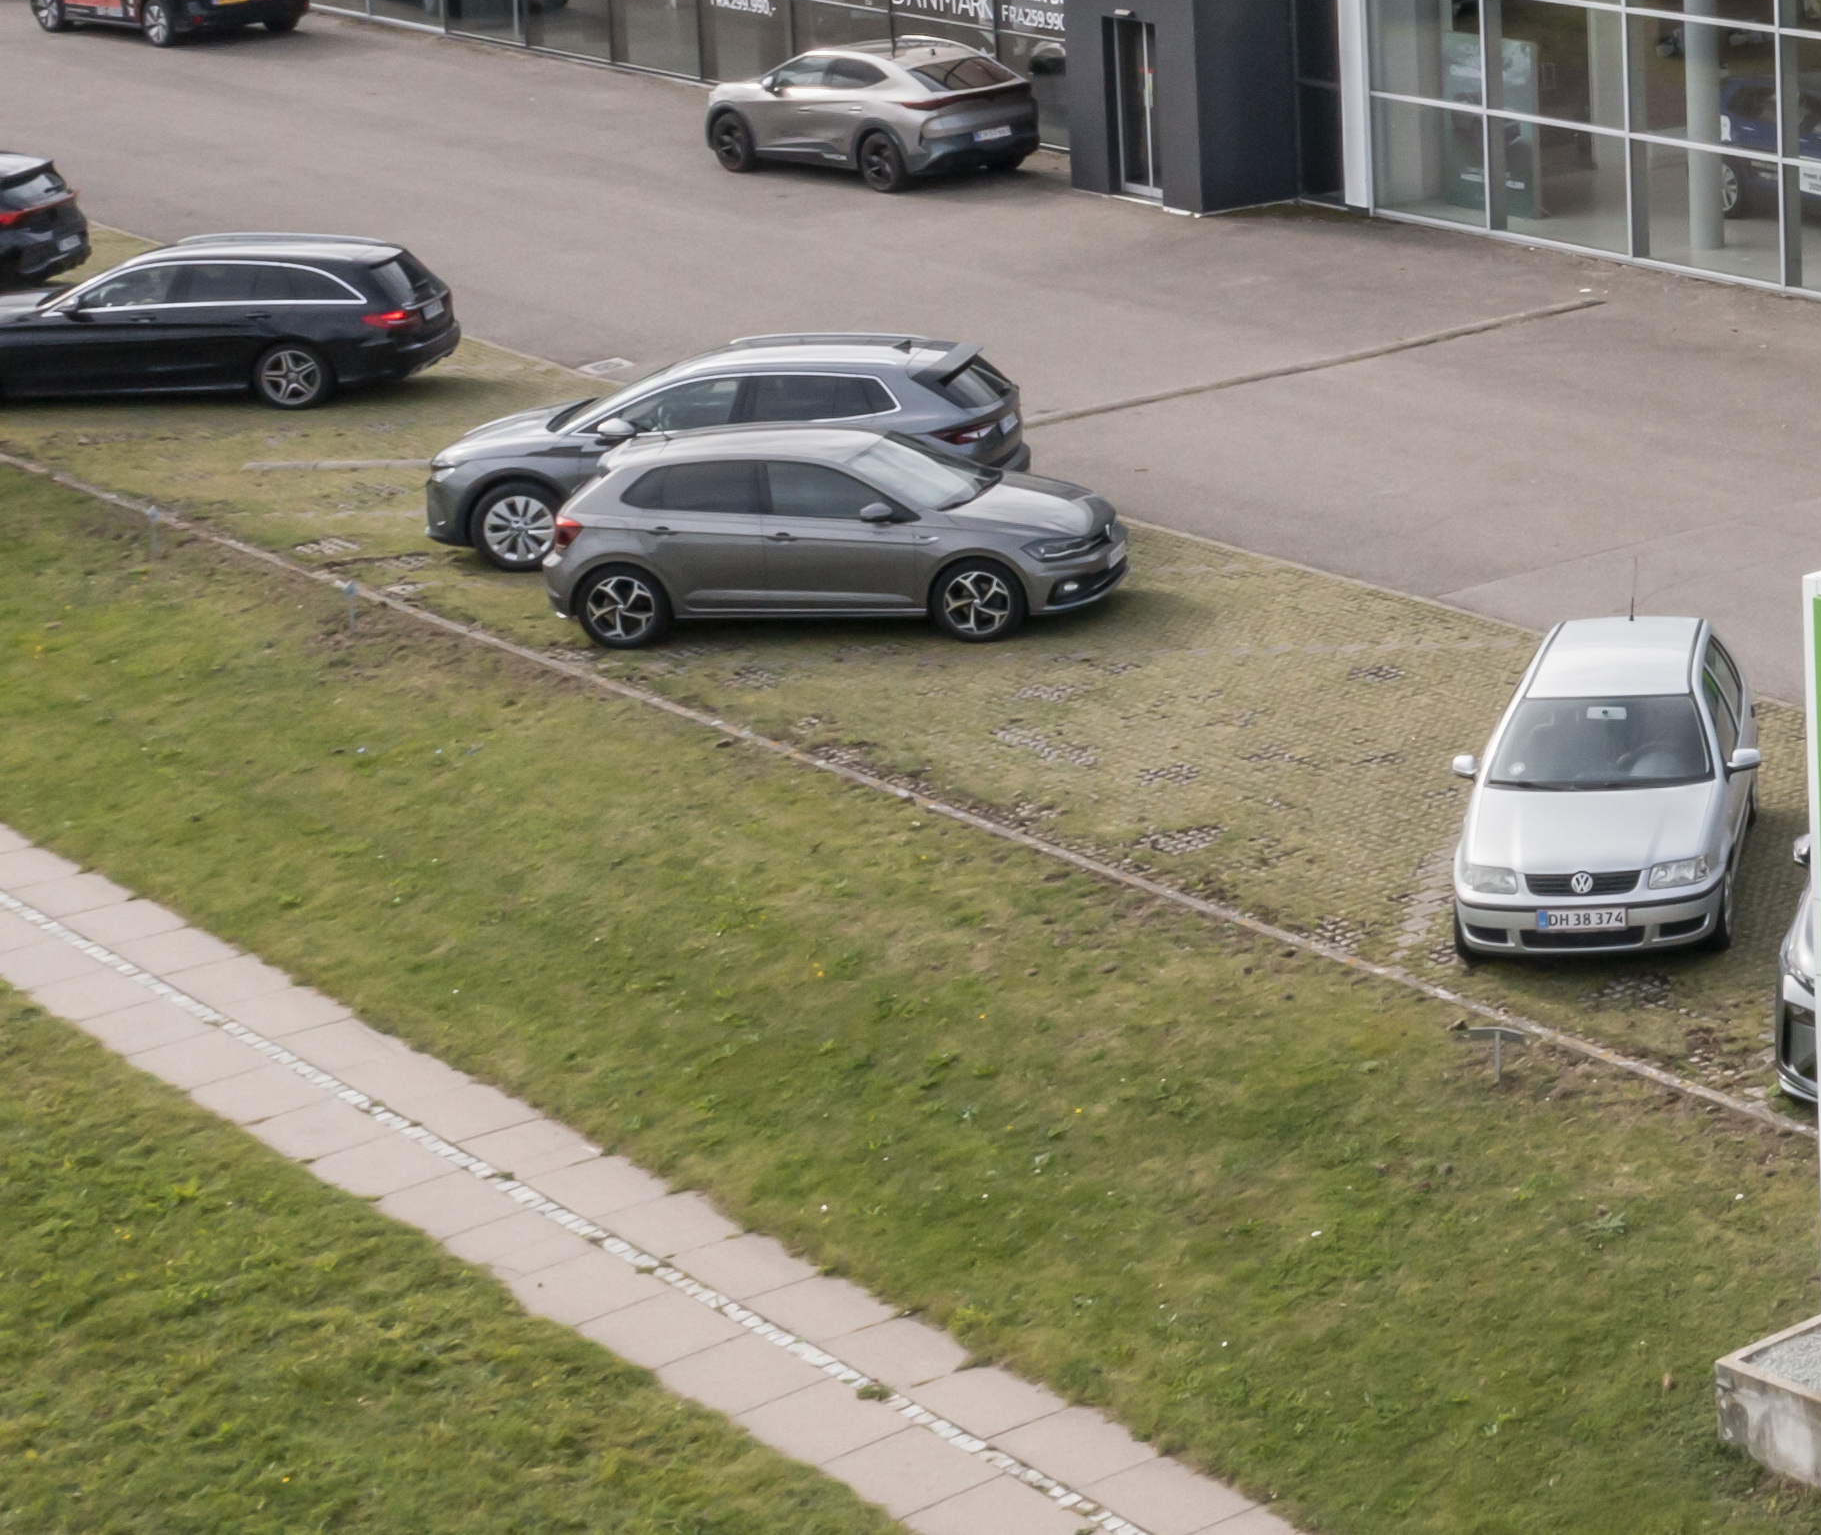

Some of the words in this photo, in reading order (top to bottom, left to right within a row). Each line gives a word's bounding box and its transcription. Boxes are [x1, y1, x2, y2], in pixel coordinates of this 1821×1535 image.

[1548, 912, 1569, 926] DH
[1573, 912, 1592, 926] 38
[1595, 911, 1624, 925] 374
